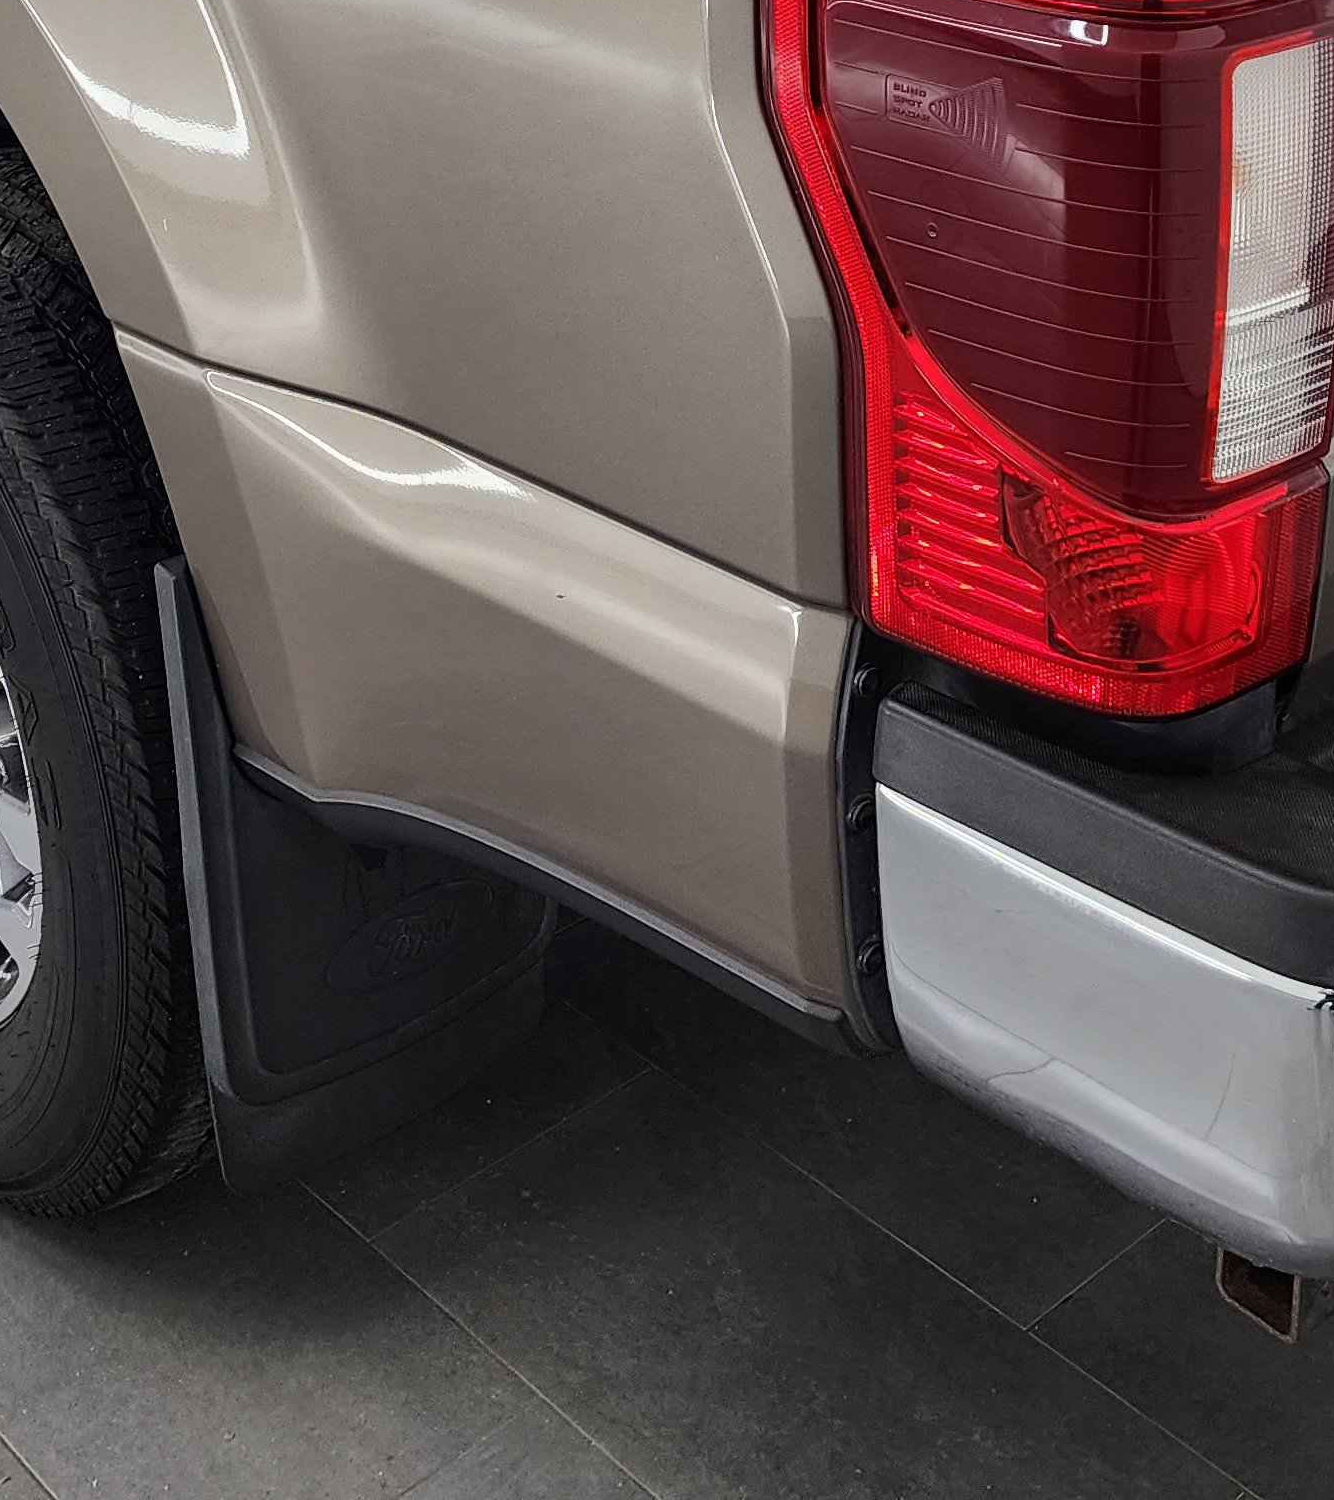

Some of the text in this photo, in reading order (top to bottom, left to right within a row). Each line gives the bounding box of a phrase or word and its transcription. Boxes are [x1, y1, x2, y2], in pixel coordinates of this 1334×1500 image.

[893, 82, 926, 97] BLIND
[893, 95, 923, 109] SPOT
[893, 107, 930, 122] RADAR
